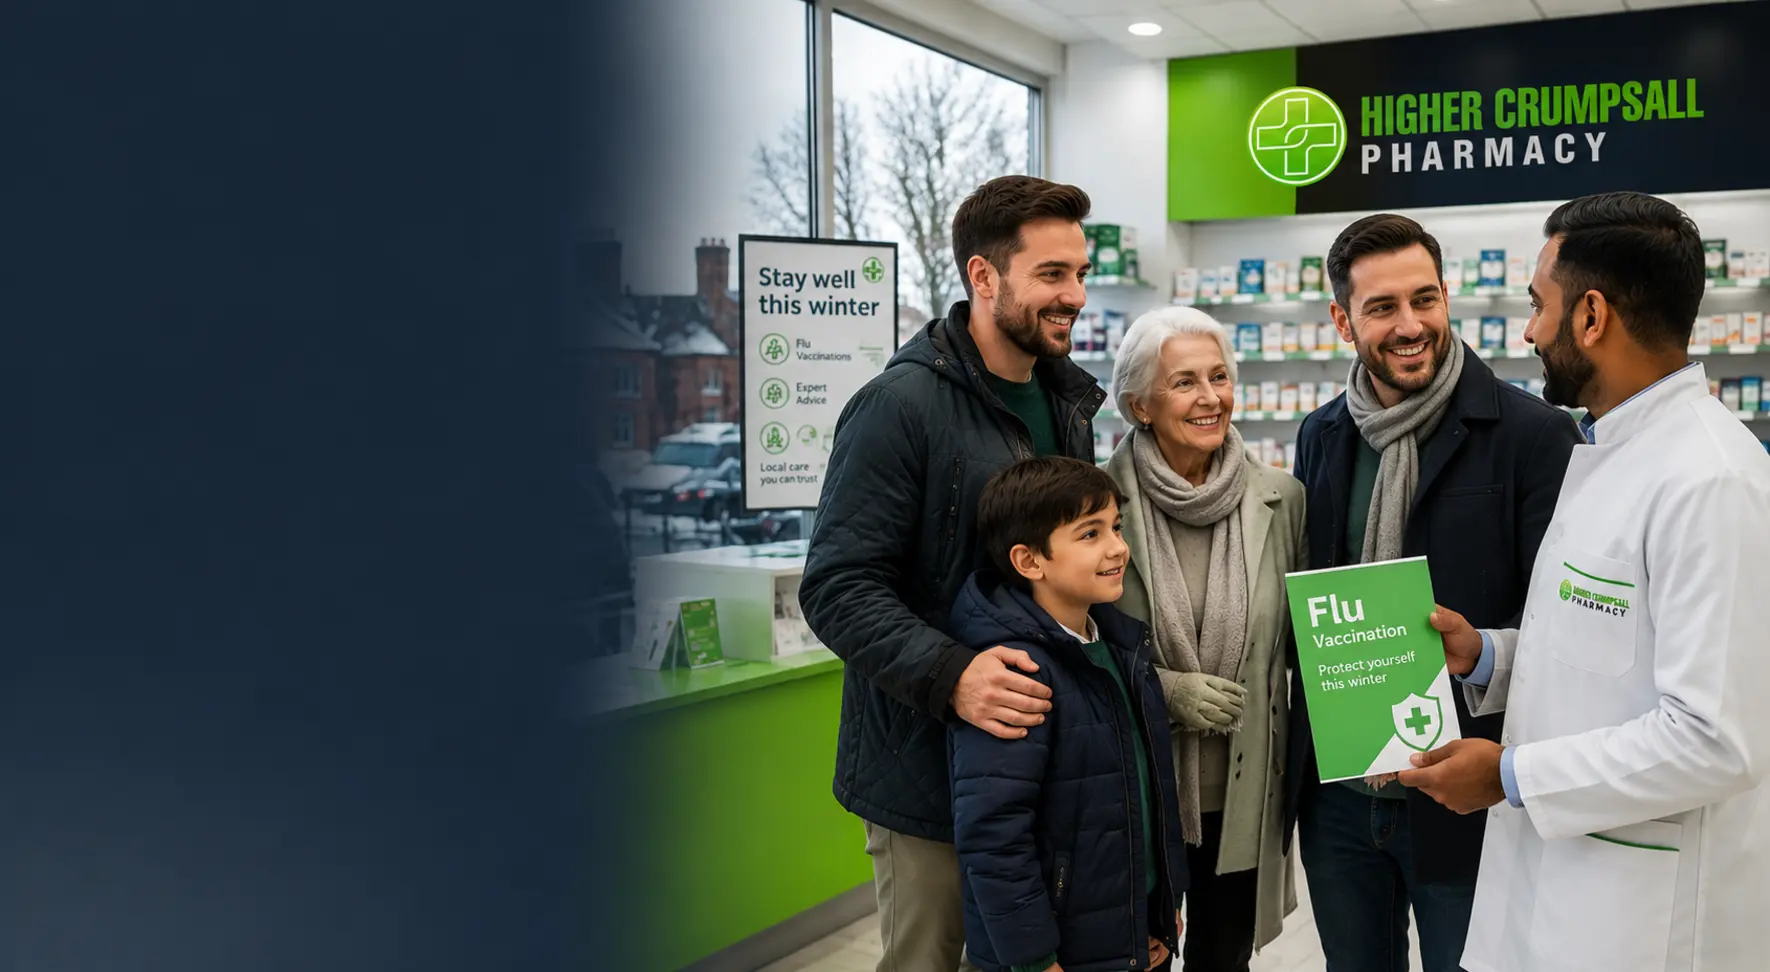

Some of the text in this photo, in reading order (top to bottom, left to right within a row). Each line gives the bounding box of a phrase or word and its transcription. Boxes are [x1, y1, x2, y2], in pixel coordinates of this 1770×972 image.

[1361, 78, 1704, 137] HIGHER CRUMPSALL
[1361, 131, 1607, 175] PHARMACY
[759, 267, 855, 292] Stay well
[759, 294, 879, 316] this winter
[796, 339, 811, 348] Flu
[797, 352, 851, 361] Vaccinations
[796, 383, 827, 394] Expert
[796, 396, 827, 404] Advice
[760, 463, 809, 472] Local care
[760, 474, 818, 486] you can trust
[1307, 594, 1365, 627] Flu
[1572, 596, 1626, 617] PHARMACY
[1313, 624, 1407, 648] Vaccination
[1318, 651, 1416, 676] Protect yourself
[1321, 673, 1387, 691] this winter
